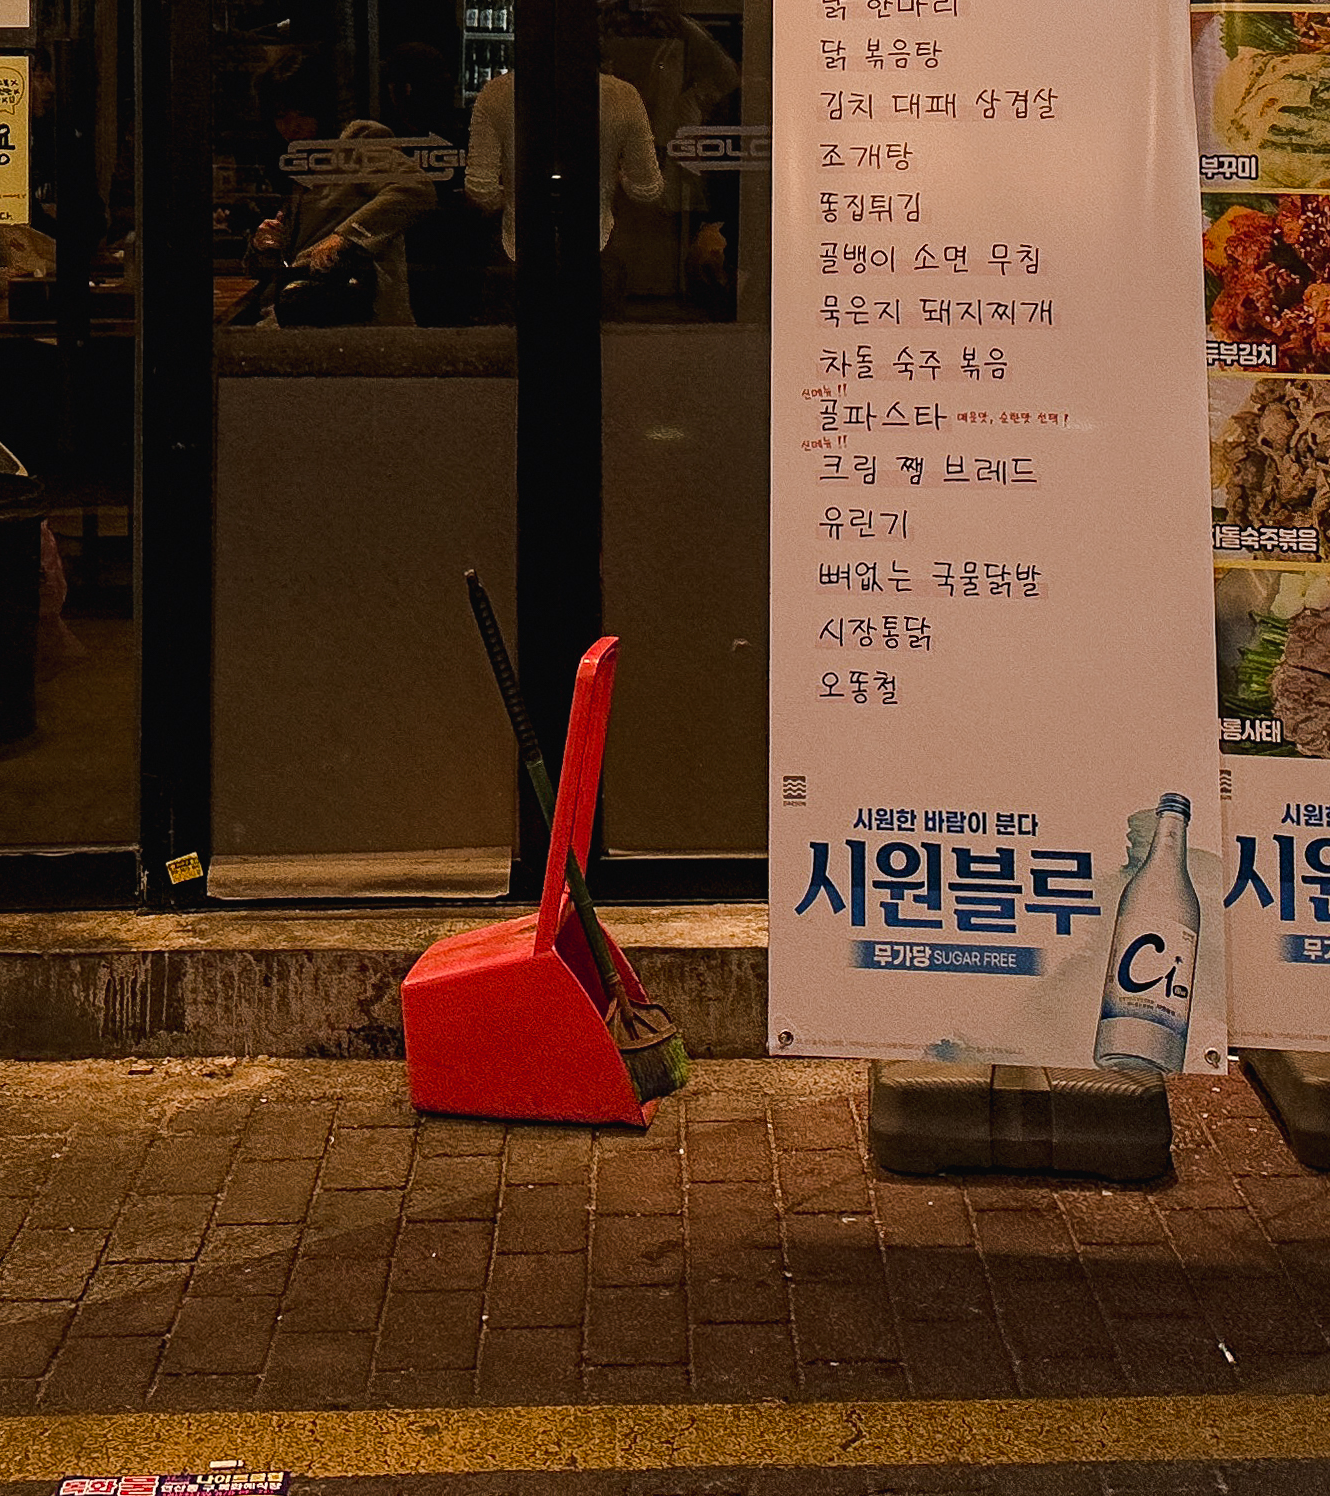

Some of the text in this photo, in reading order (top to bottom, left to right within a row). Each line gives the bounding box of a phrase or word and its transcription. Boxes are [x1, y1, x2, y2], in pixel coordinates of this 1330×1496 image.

[819, 38, 943, 71] 닭 볶음탕
[819, 87, 1059, 121] 김치 대패 삼겹살
[819, 142, 913, 170] 조개탕
[1200, 156, 1257, 179] 부꾸미
[819, 191, 921, 224] 똥집튀김
[819, 241, 1040, 276] 골뱅이 소면 무침
[819, 295, 1054, 328] 묵은지 돼지찌개
[819, 346, 1009, 381] 차돌 숙주 볶음
[820, 398, 948, 432] 골파스타
[820, 455, 876, 485] 크림
[943, 454, 1038, 486] 브레드
[819, 506, 908, 540] 유린기
[819, 559, 1043, 598] 뼈없는 국물닭발
[819, 614, 932, 652] 시장통닭
[853, 808, 1039, 837] 시원한 바람이 분다
[794, 838, 1103, 937] 시원블루
[873, 944, 1017, 969] 무가당 SUGAR FREE
